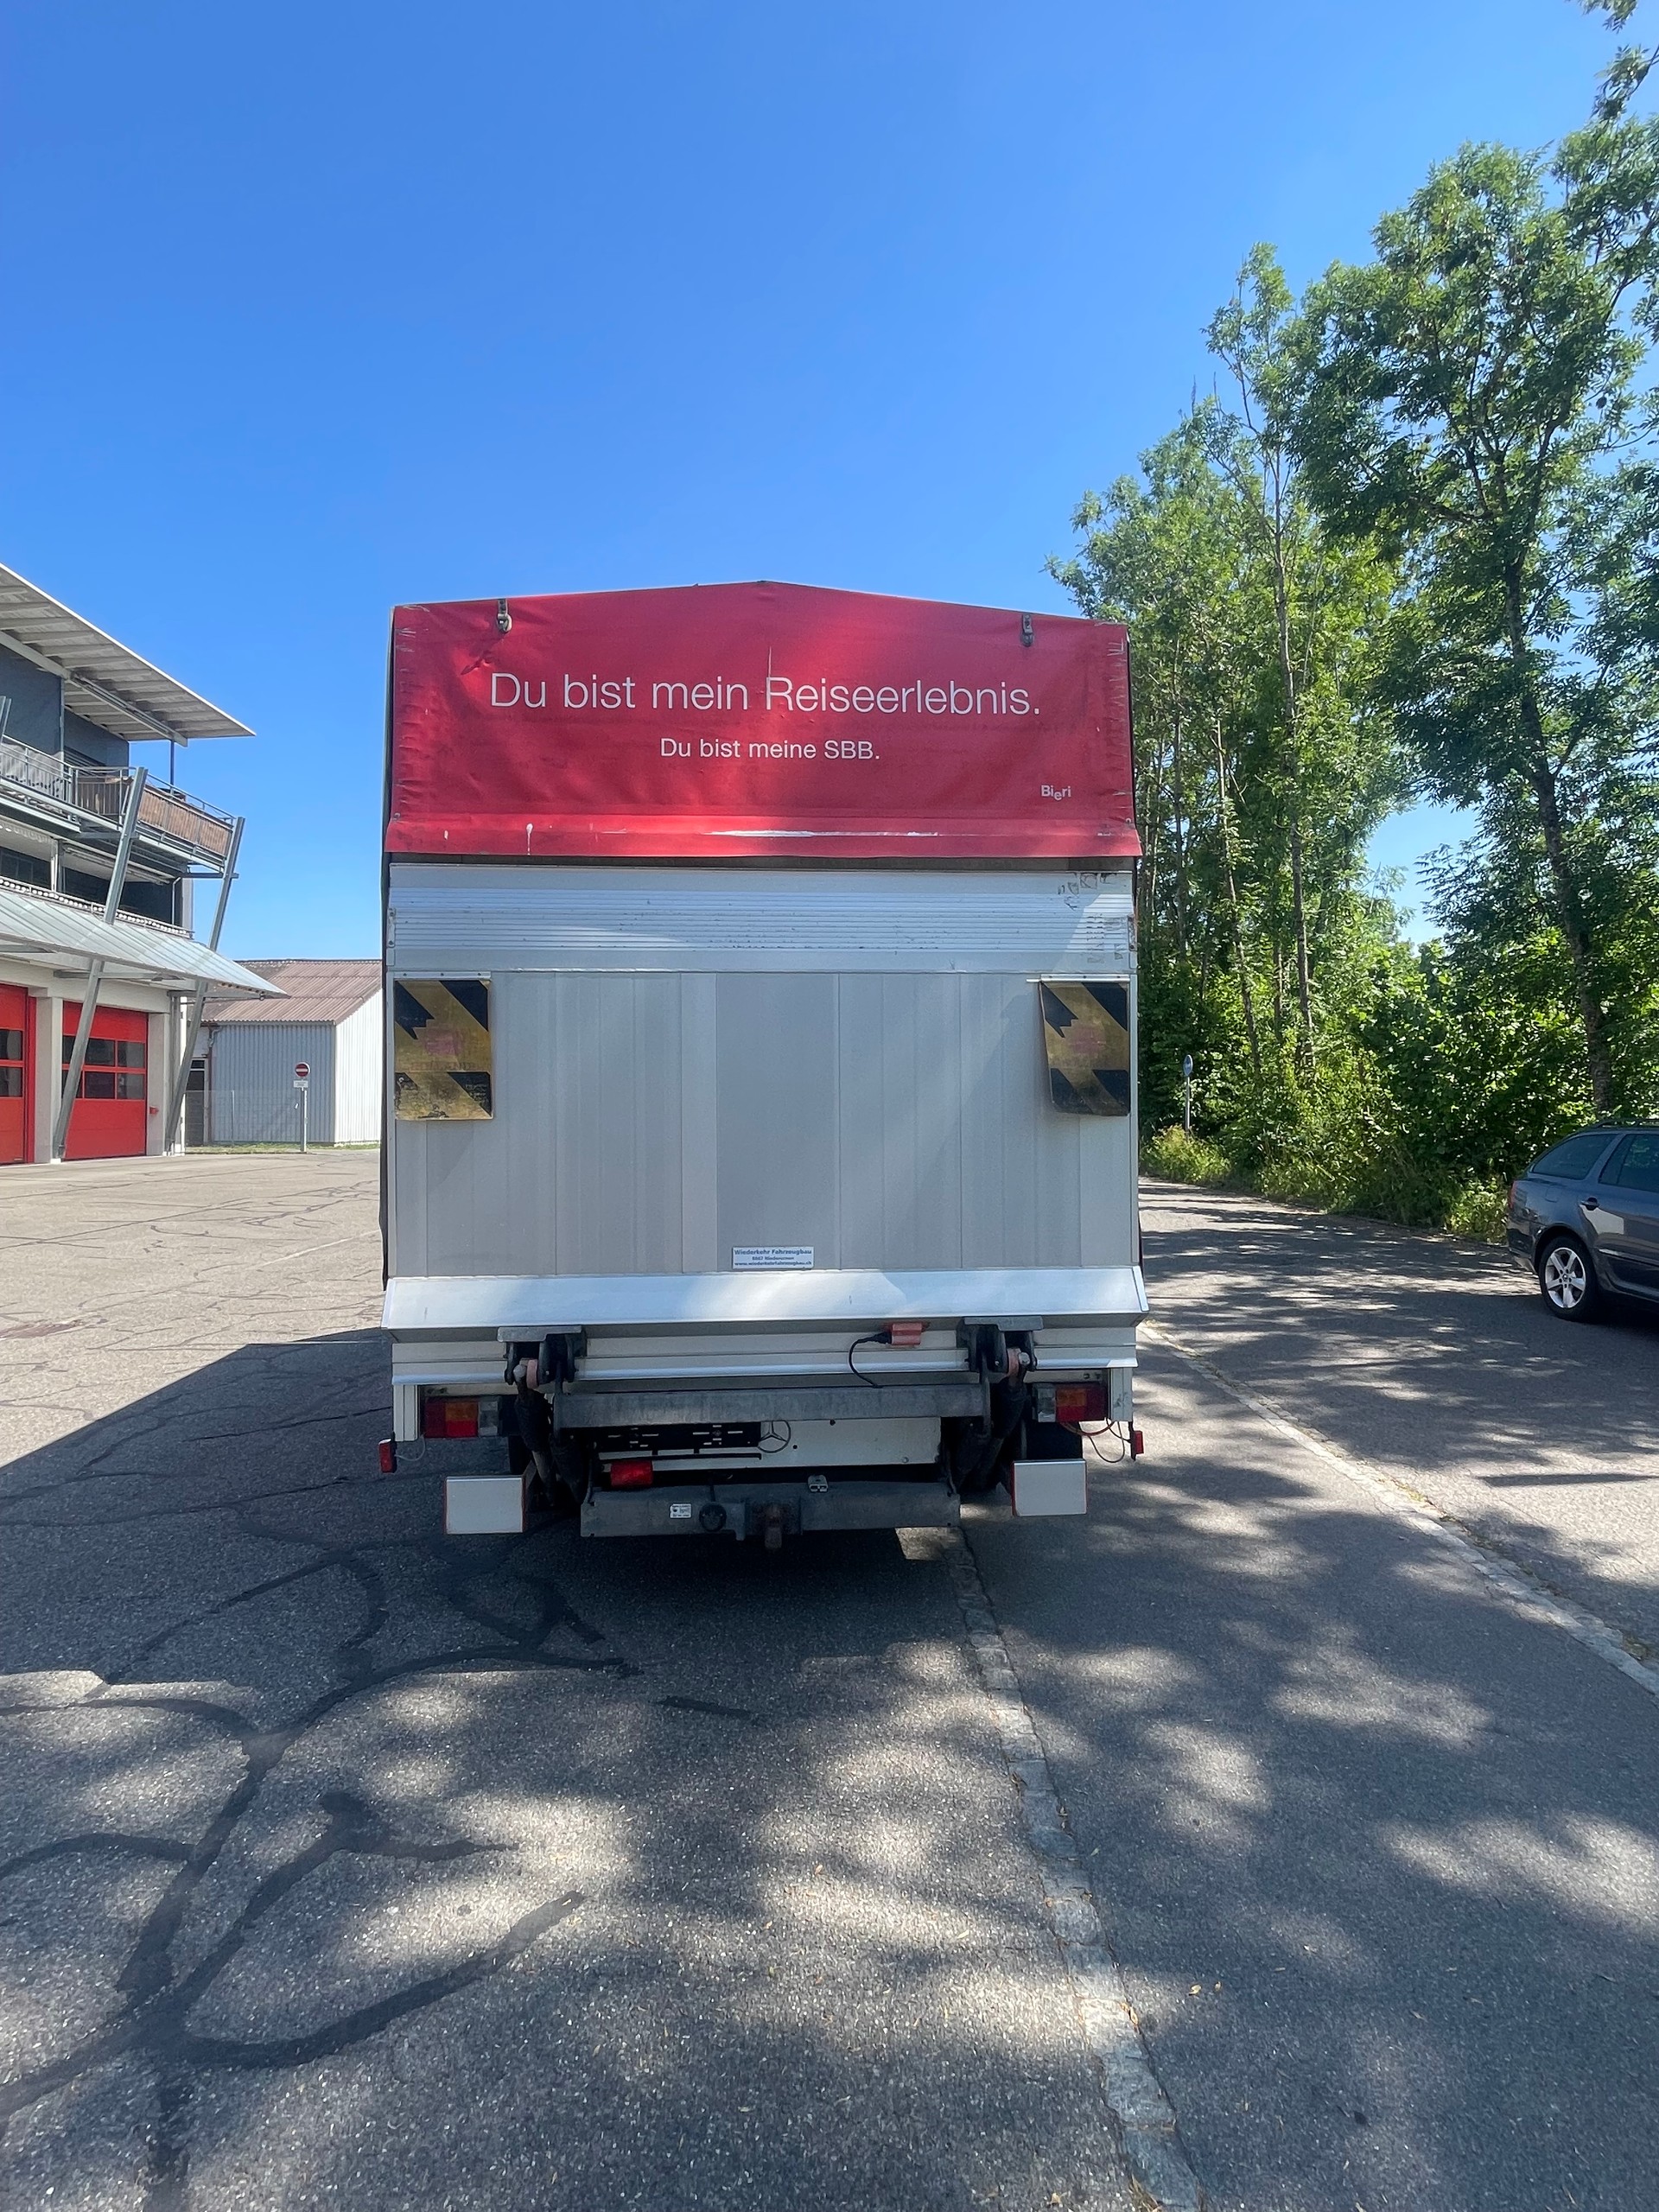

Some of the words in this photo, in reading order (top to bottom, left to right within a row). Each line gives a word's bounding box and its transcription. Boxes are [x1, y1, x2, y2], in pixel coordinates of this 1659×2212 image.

[492, 673, 546, 709] Du
[564, 674, 636, 709] bist
[653, 676, 749, 710] mein
[766, 677, 1040, 715] Reiseerlebnis.
[661, 738, 691, 757] Du
[701, 739, 741, 758] bist
[749, 741, 817, 759] meine
[824, 741, 880, 760] SBB.
[1041, 785, 1071, 801] Bieri
